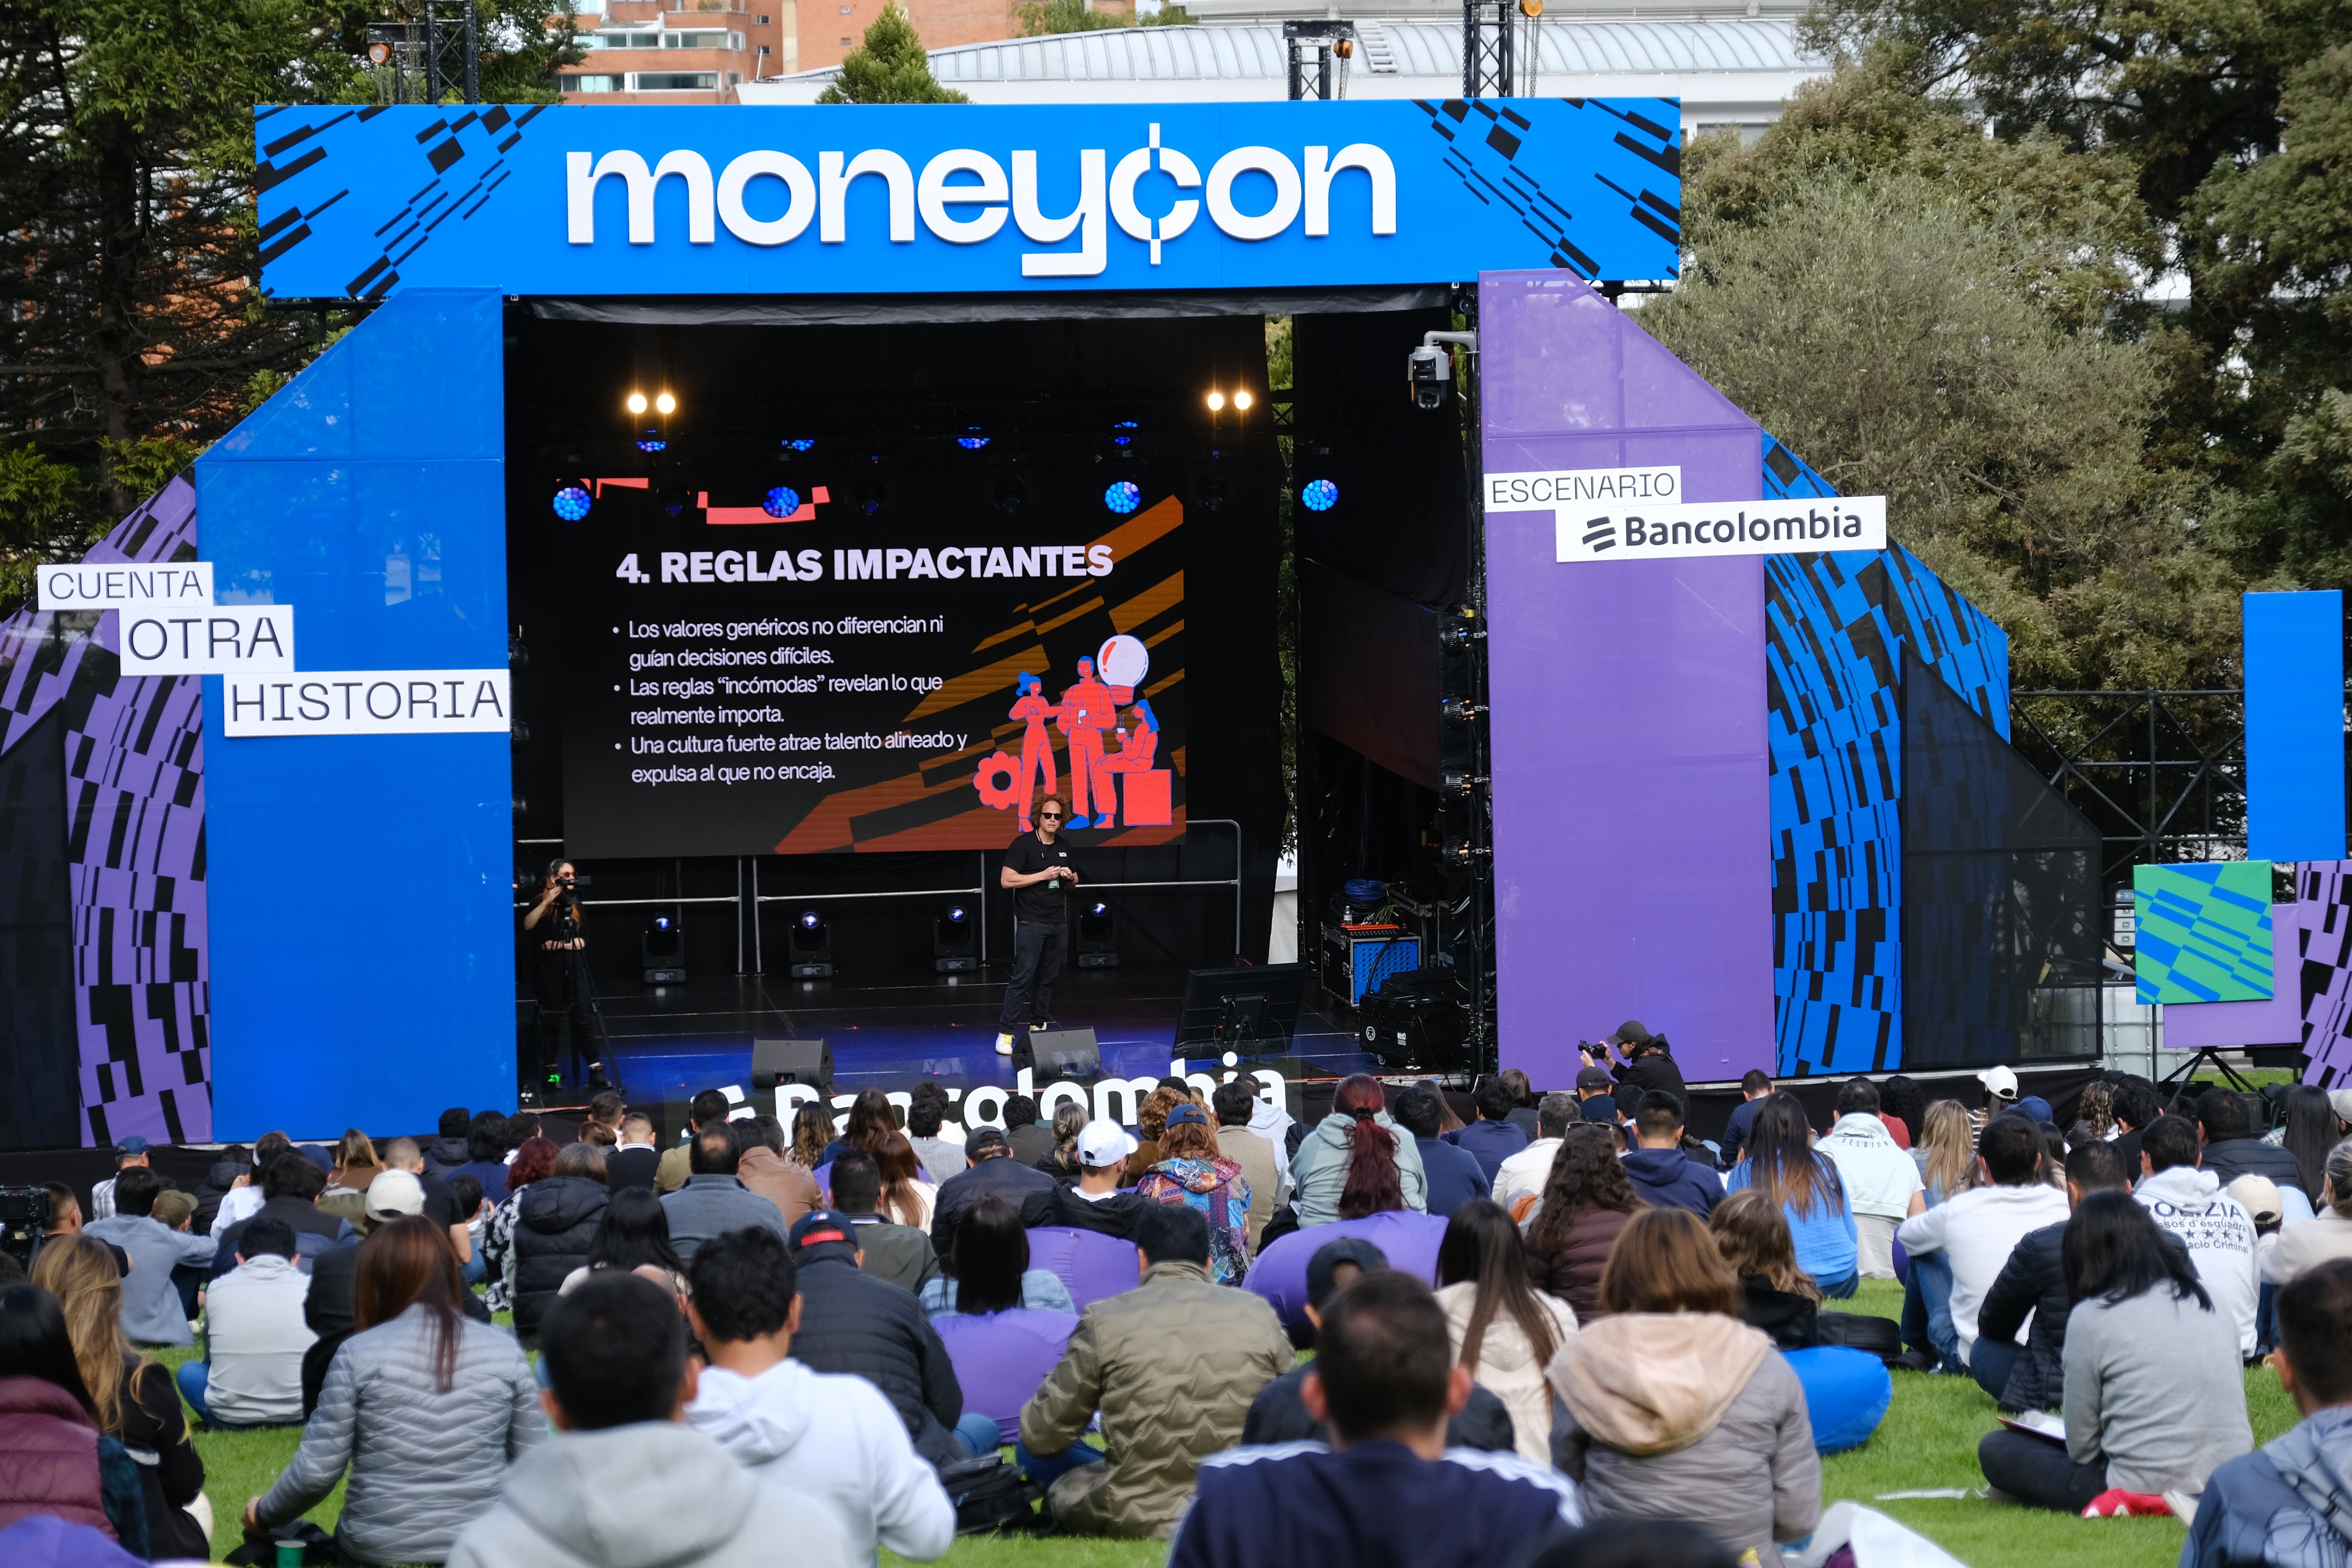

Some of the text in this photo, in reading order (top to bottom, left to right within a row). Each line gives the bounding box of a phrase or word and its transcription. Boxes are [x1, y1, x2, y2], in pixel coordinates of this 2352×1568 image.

[1493, 473, 1674, 503] ESCENARIO
[1626, 506, 1860, 546] Bancolombia
[616, 544, 1113, 583] 4. REGLAS IMPACTANTES
[48, 571, 204, 599] CUENTA
[128, 617, 283, 660] OTRA
[629, 615, 943, 641] Los valores genéricos no diferencian ni
[629, 646, 834, 671] guían decisiones difíciles.
[630, 678, 660, 696] Las
[663, 677, 715, 699] reglas
[829, 674, 889, 692] revelan
[892, 673, 907, 691] lo
[911, 677, 943, 694] que
[233, 681, 503, 722] HISTORIA
[631, 705, 784, 727] realmente importa.
[631, 730, 968, 754] Una cultura fuerte atrae talento alineado y
[631, 761, 835, 787] expulsa al que no encaja.
[775, 1051, 1287, 1148] Banoloma
[2144, 1202, 2245, 1222] OZIA
[2213, 1240, 2249, 1254] Criminal
